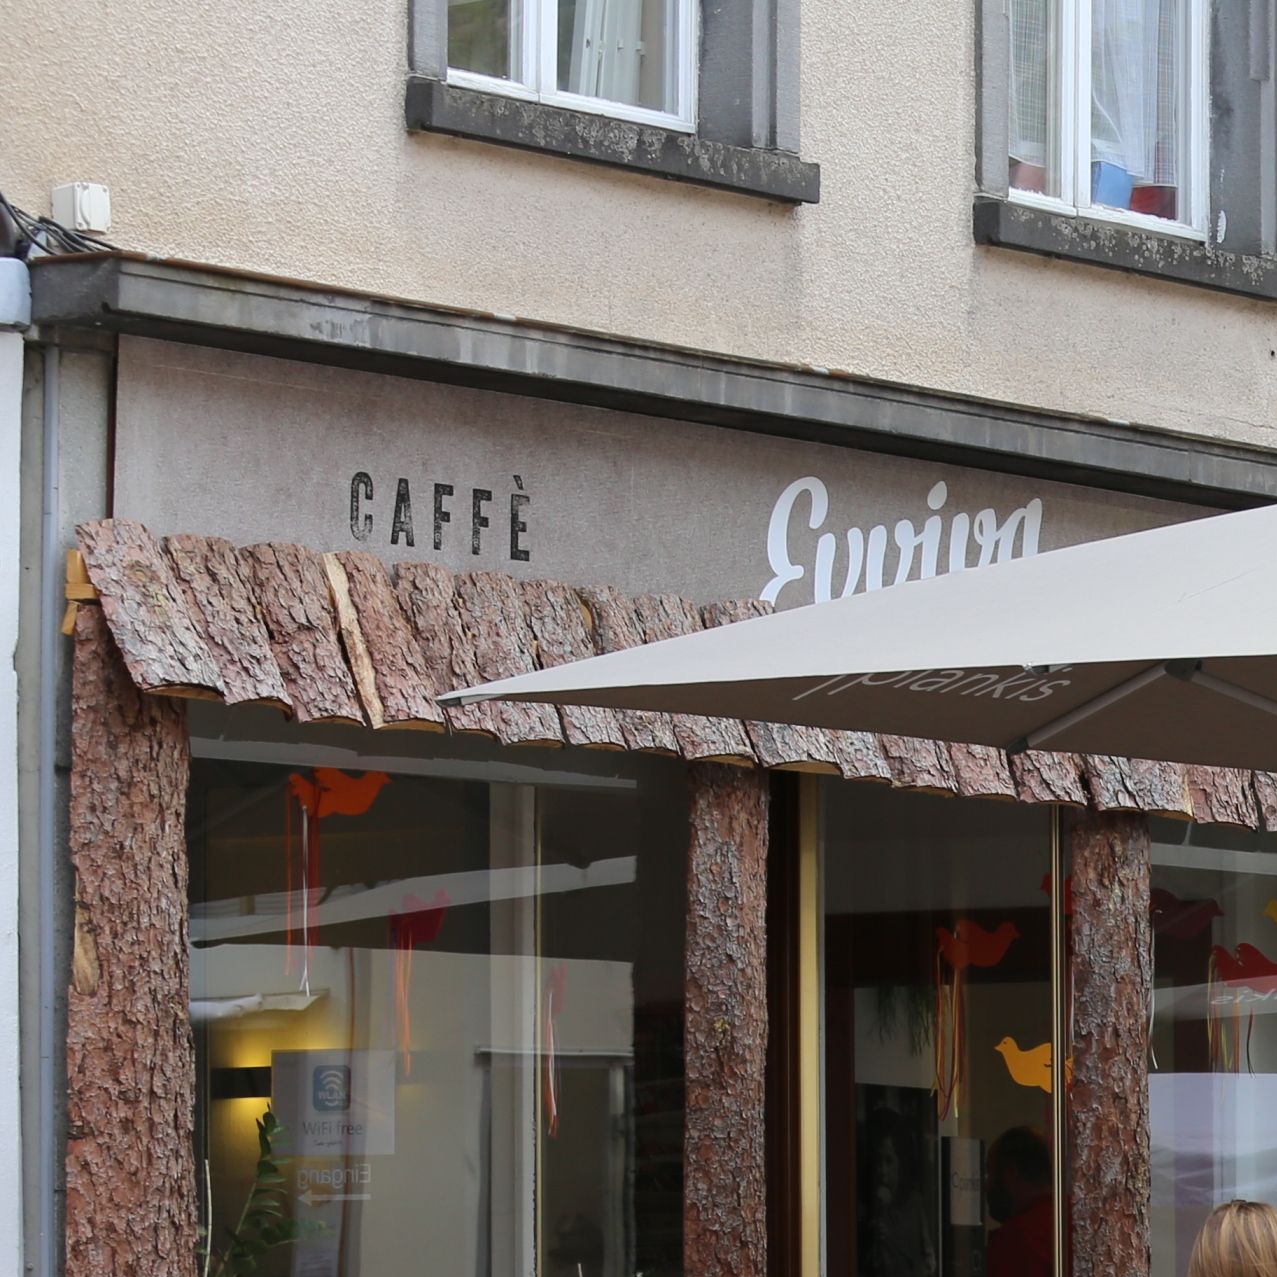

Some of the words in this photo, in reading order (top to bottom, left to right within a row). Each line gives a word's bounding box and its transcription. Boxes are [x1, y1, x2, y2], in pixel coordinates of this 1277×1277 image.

[350, 471, 531, 562] CAFFÈ
[759, 476, 1043, 608] Evviva
[302, 1121, 333, 1136] WiFi
[337, 1120, 364, 1136] free
